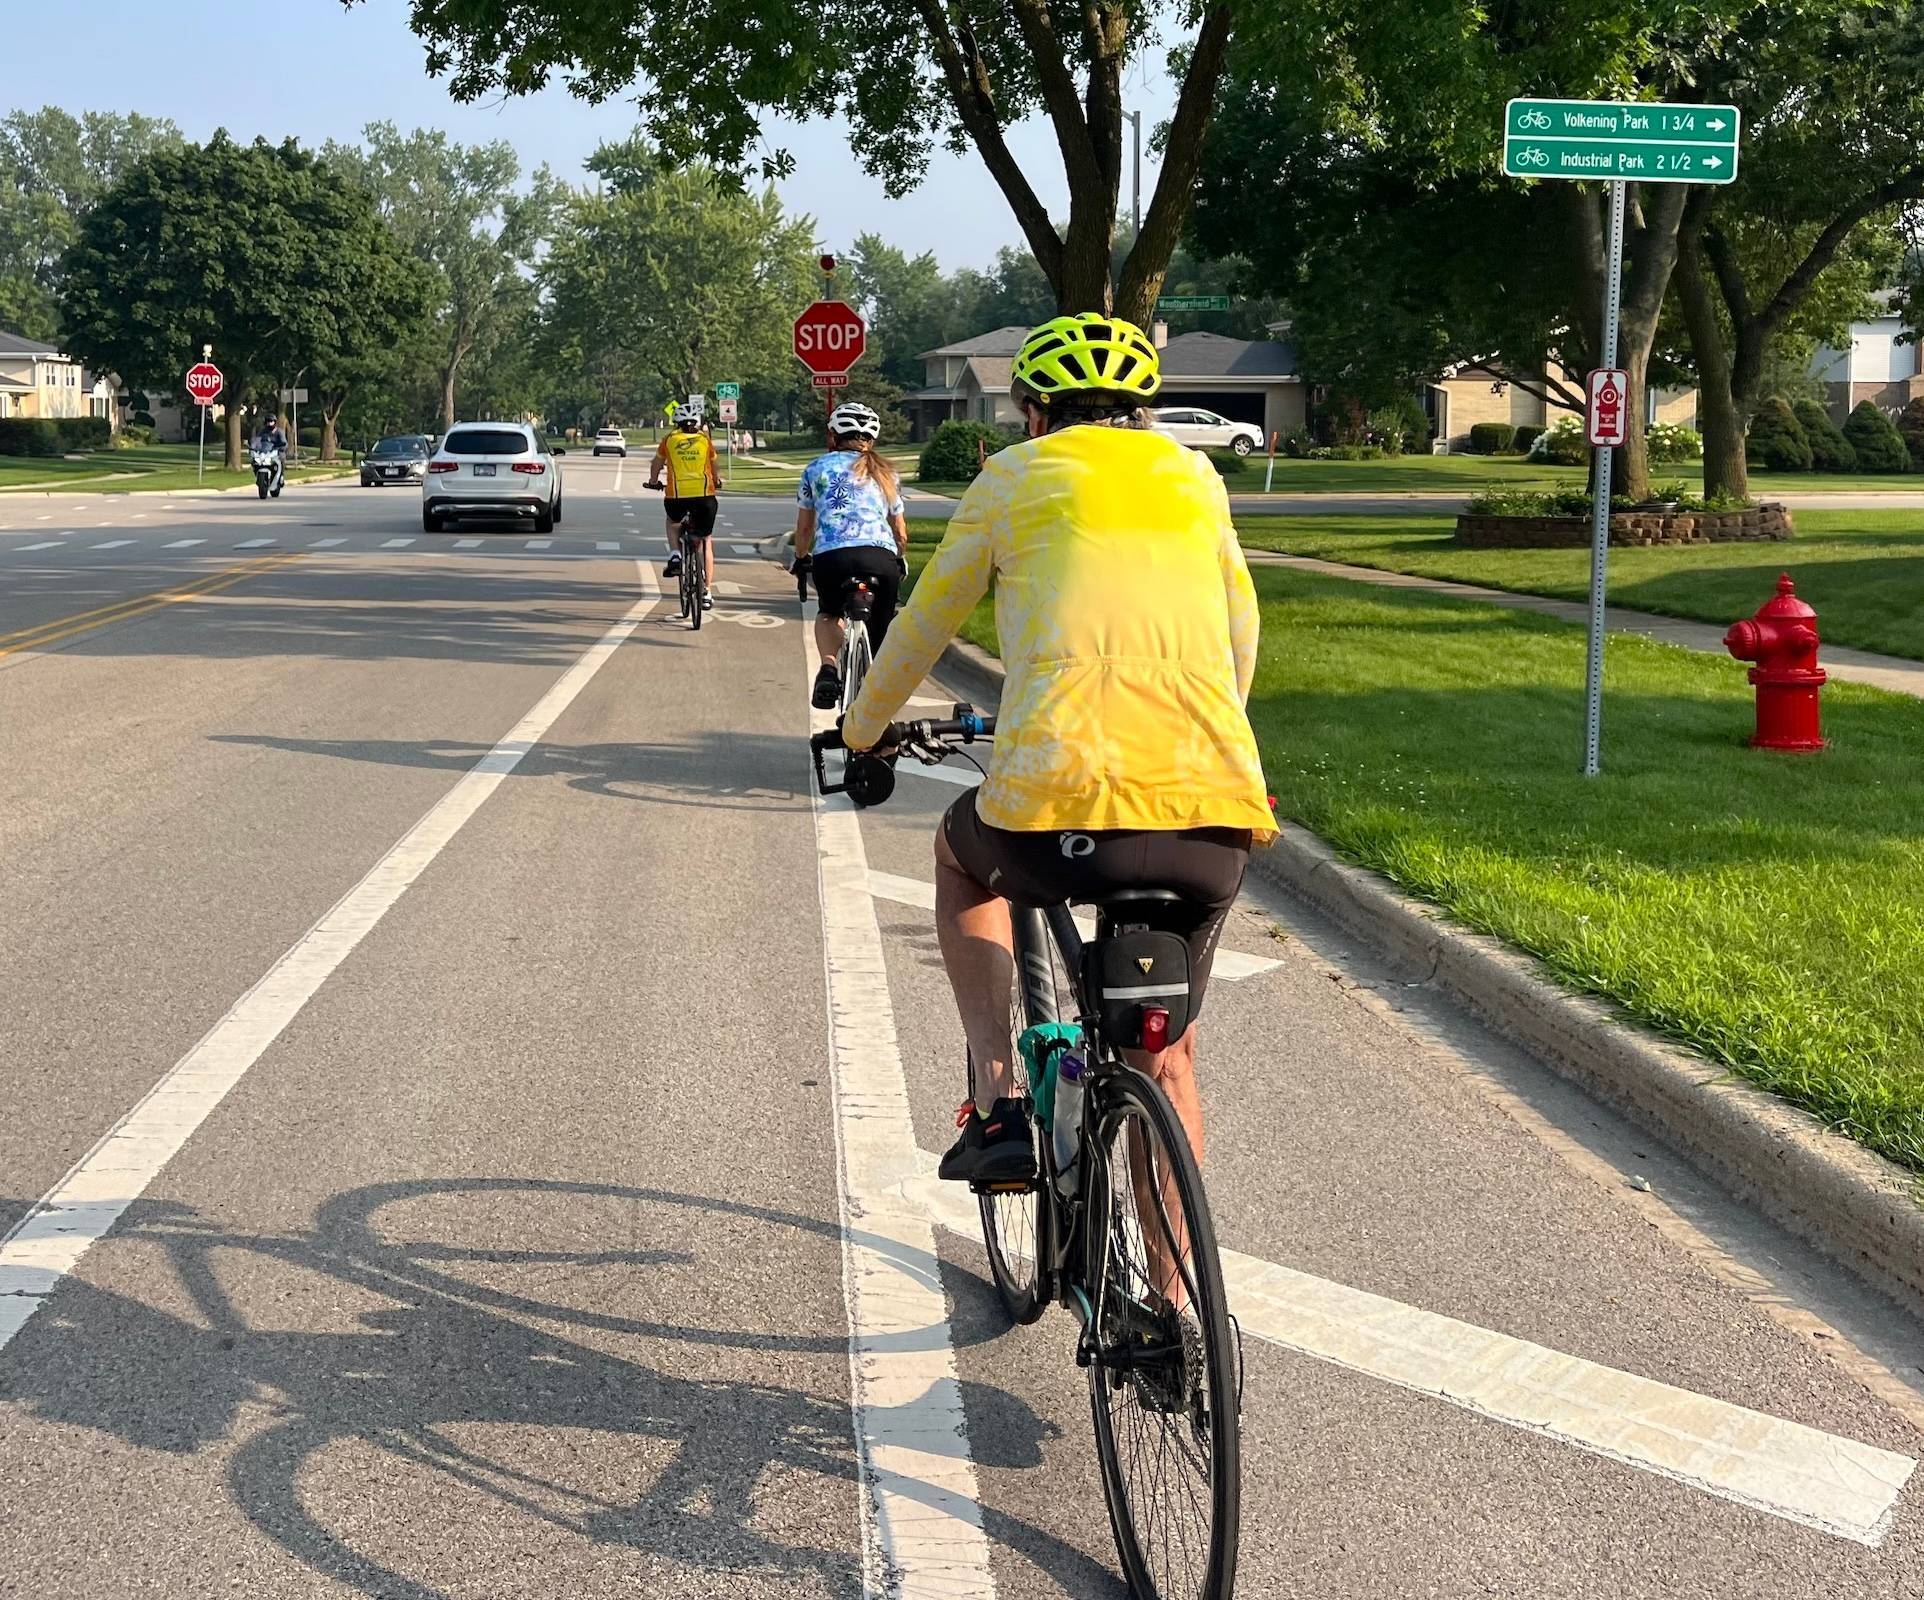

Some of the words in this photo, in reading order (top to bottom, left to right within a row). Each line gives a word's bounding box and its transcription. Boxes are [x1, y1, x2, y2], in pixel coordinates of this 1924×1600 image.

[1563, 112, 1617, 132] Volkening
[1623, 113, 1649, 130] Park
[1672, 112, 1695, 132] 3/4
[1560, 151, 1612, 168] Industrial
[1618, 153, 1644, 169] Park
[1656, 155, 1665, 170] 2
[1671, 152, 1691, 171] 1/2
[798, 323, 860, 351] STOP
[189, 373, 220, 389] STOP
